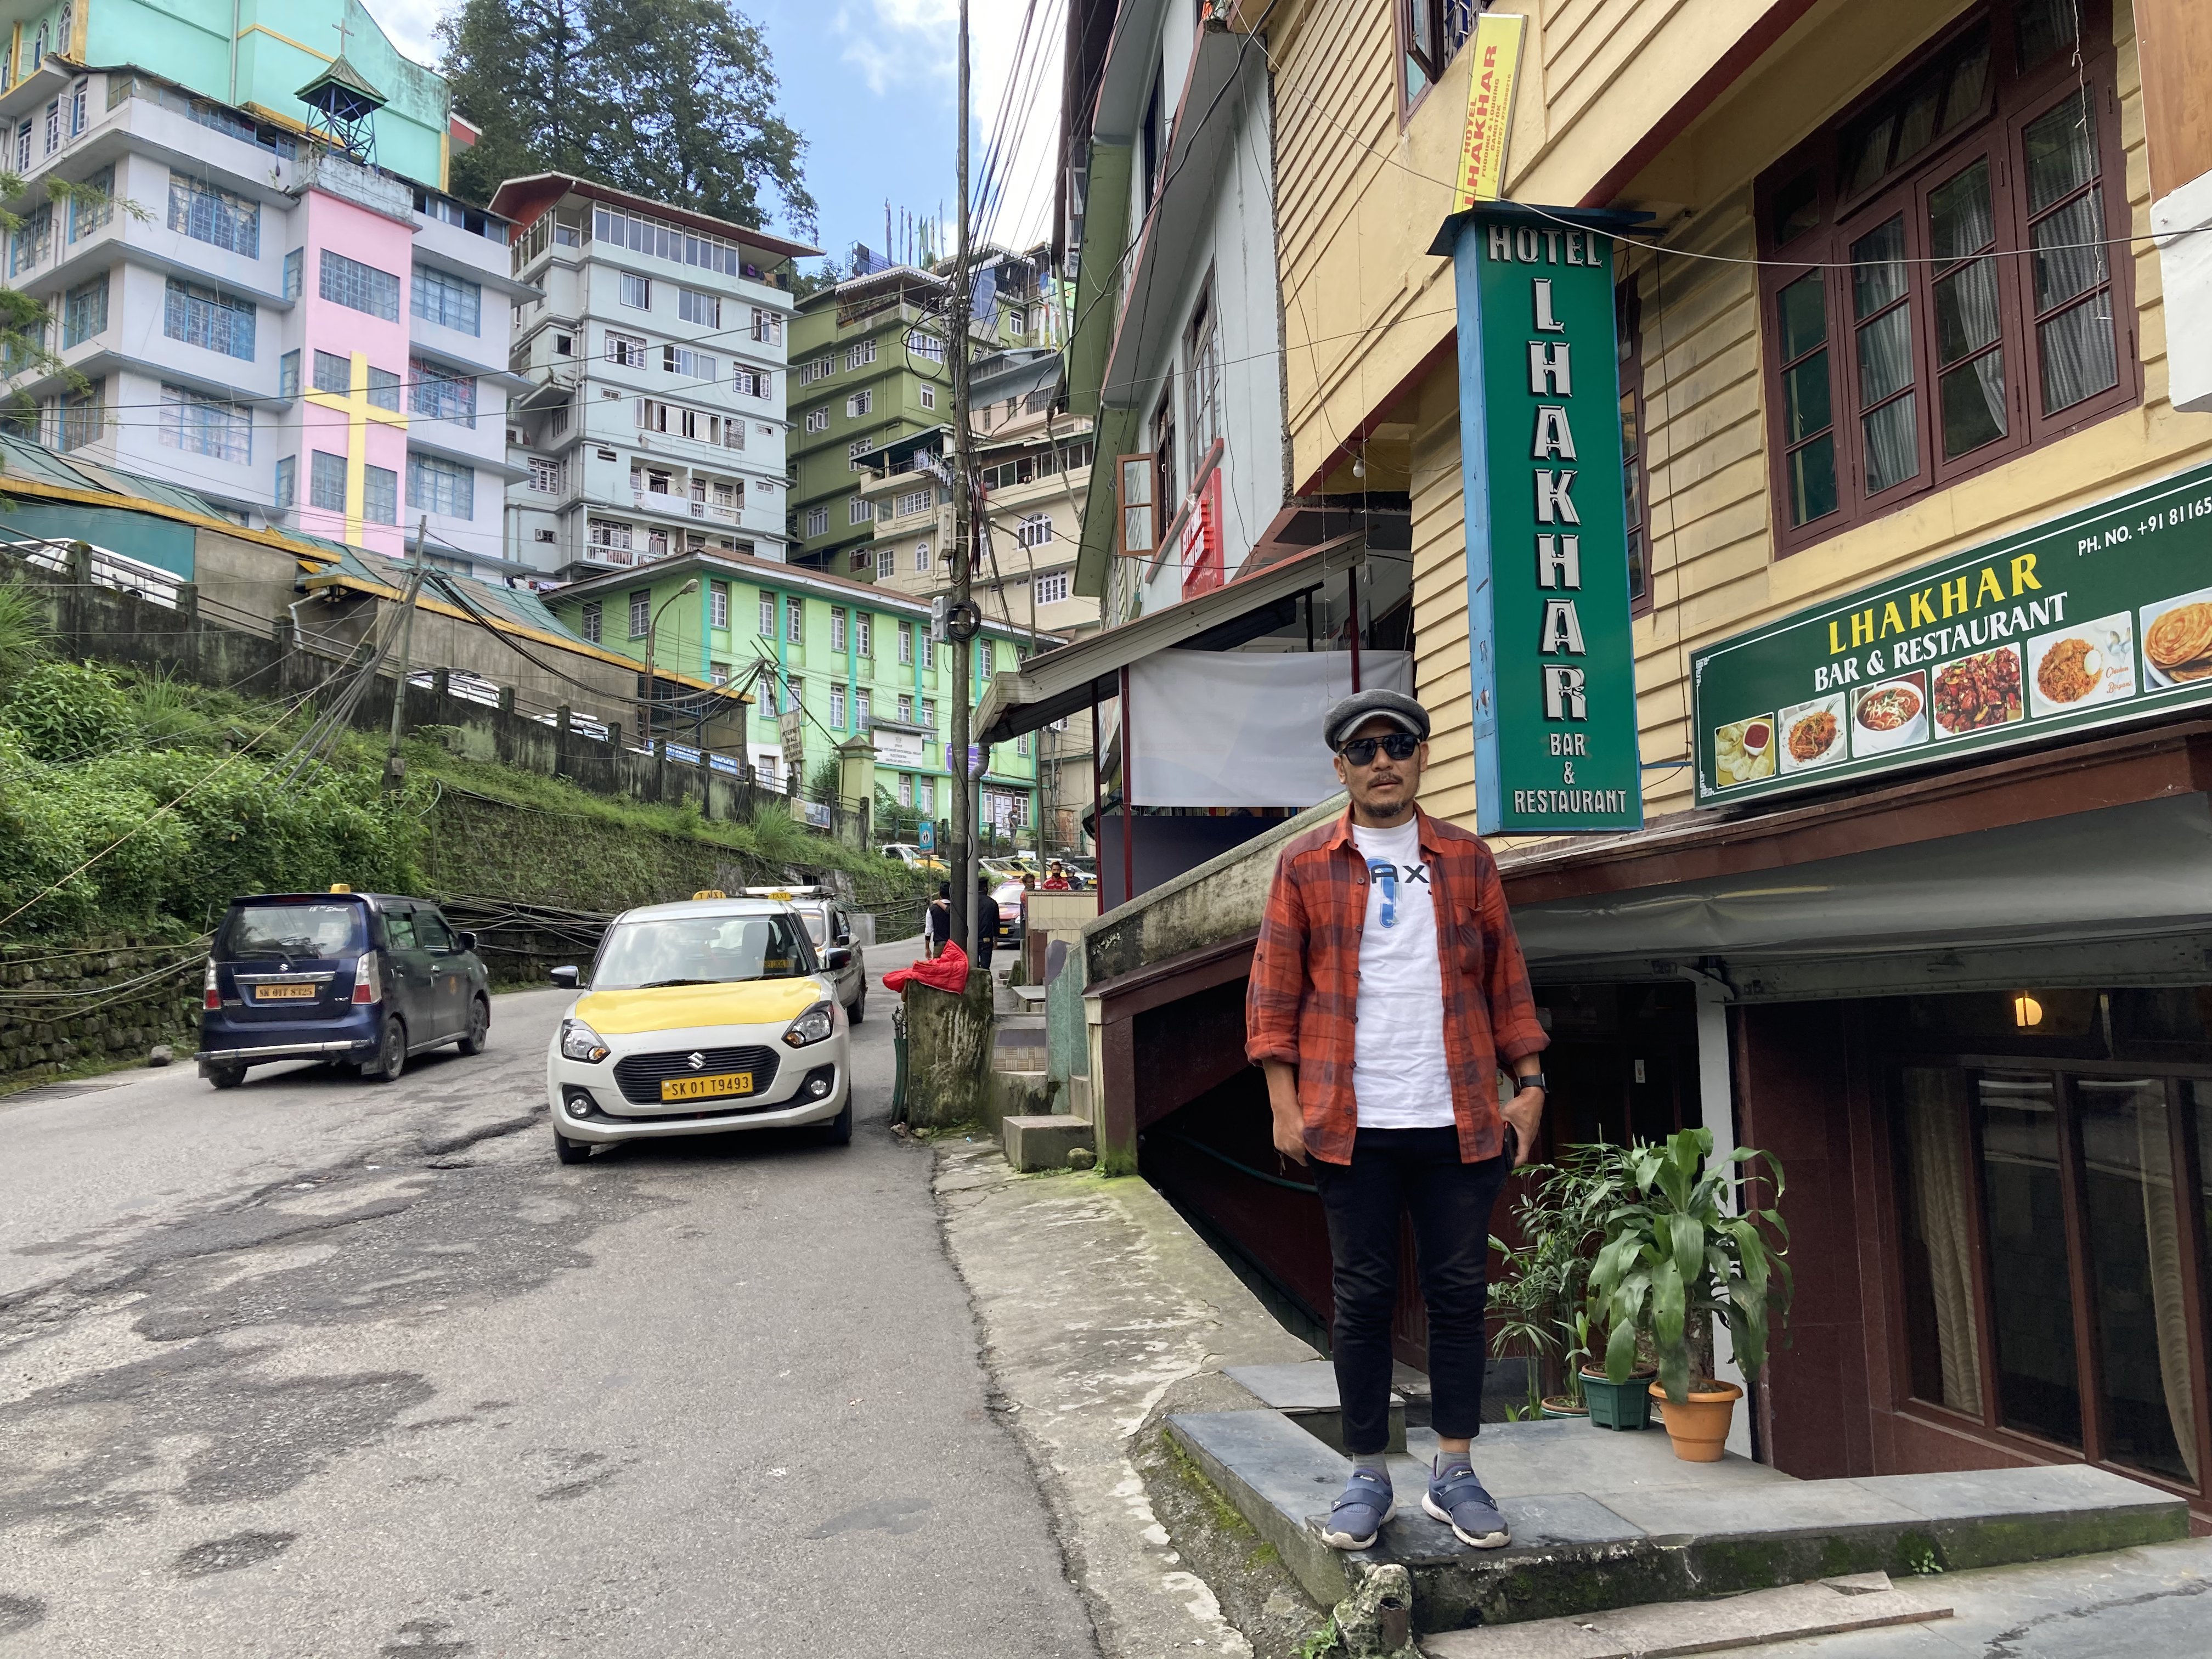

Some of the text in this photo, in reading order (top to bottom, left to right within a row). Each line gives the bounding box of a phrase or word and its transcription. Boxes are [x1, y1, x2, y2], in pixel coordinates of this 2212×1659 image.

[1464, 97, 1477, 154] HOTEL
[1464, 46, 1497, 205] LHAKHAR
[1481, 135, 1491, 177] FOODING
[1489, 78, 1499, 121] LODGING
[1491, 105, 1502, 151] GANGTOK
[1487, 224, 1603, 267] HOTEL
[1528, 278, 1588, 721] LHAKHAR
[2078, 535, 2102, 556] PH.
[2104, 526, 2132, 548] NO.
[2137, 513, 2163, 536] +91
[1828, 553, 2042, 655] LHAKHAR
[1814, 591, 2068, 692] BAR & RESTAURANT
[1550, 732, 1586, 757] BAR
[1564, 760, 1576, 785] &
[1514, 789, 1627, 814] RESTAURANT
[698, 891, 723, 900] TAXI
[672, 1082, 686, 1096] SK
[691, 1080, 704, 1094] 01
[710, 1076, 749, 1092] T9493
